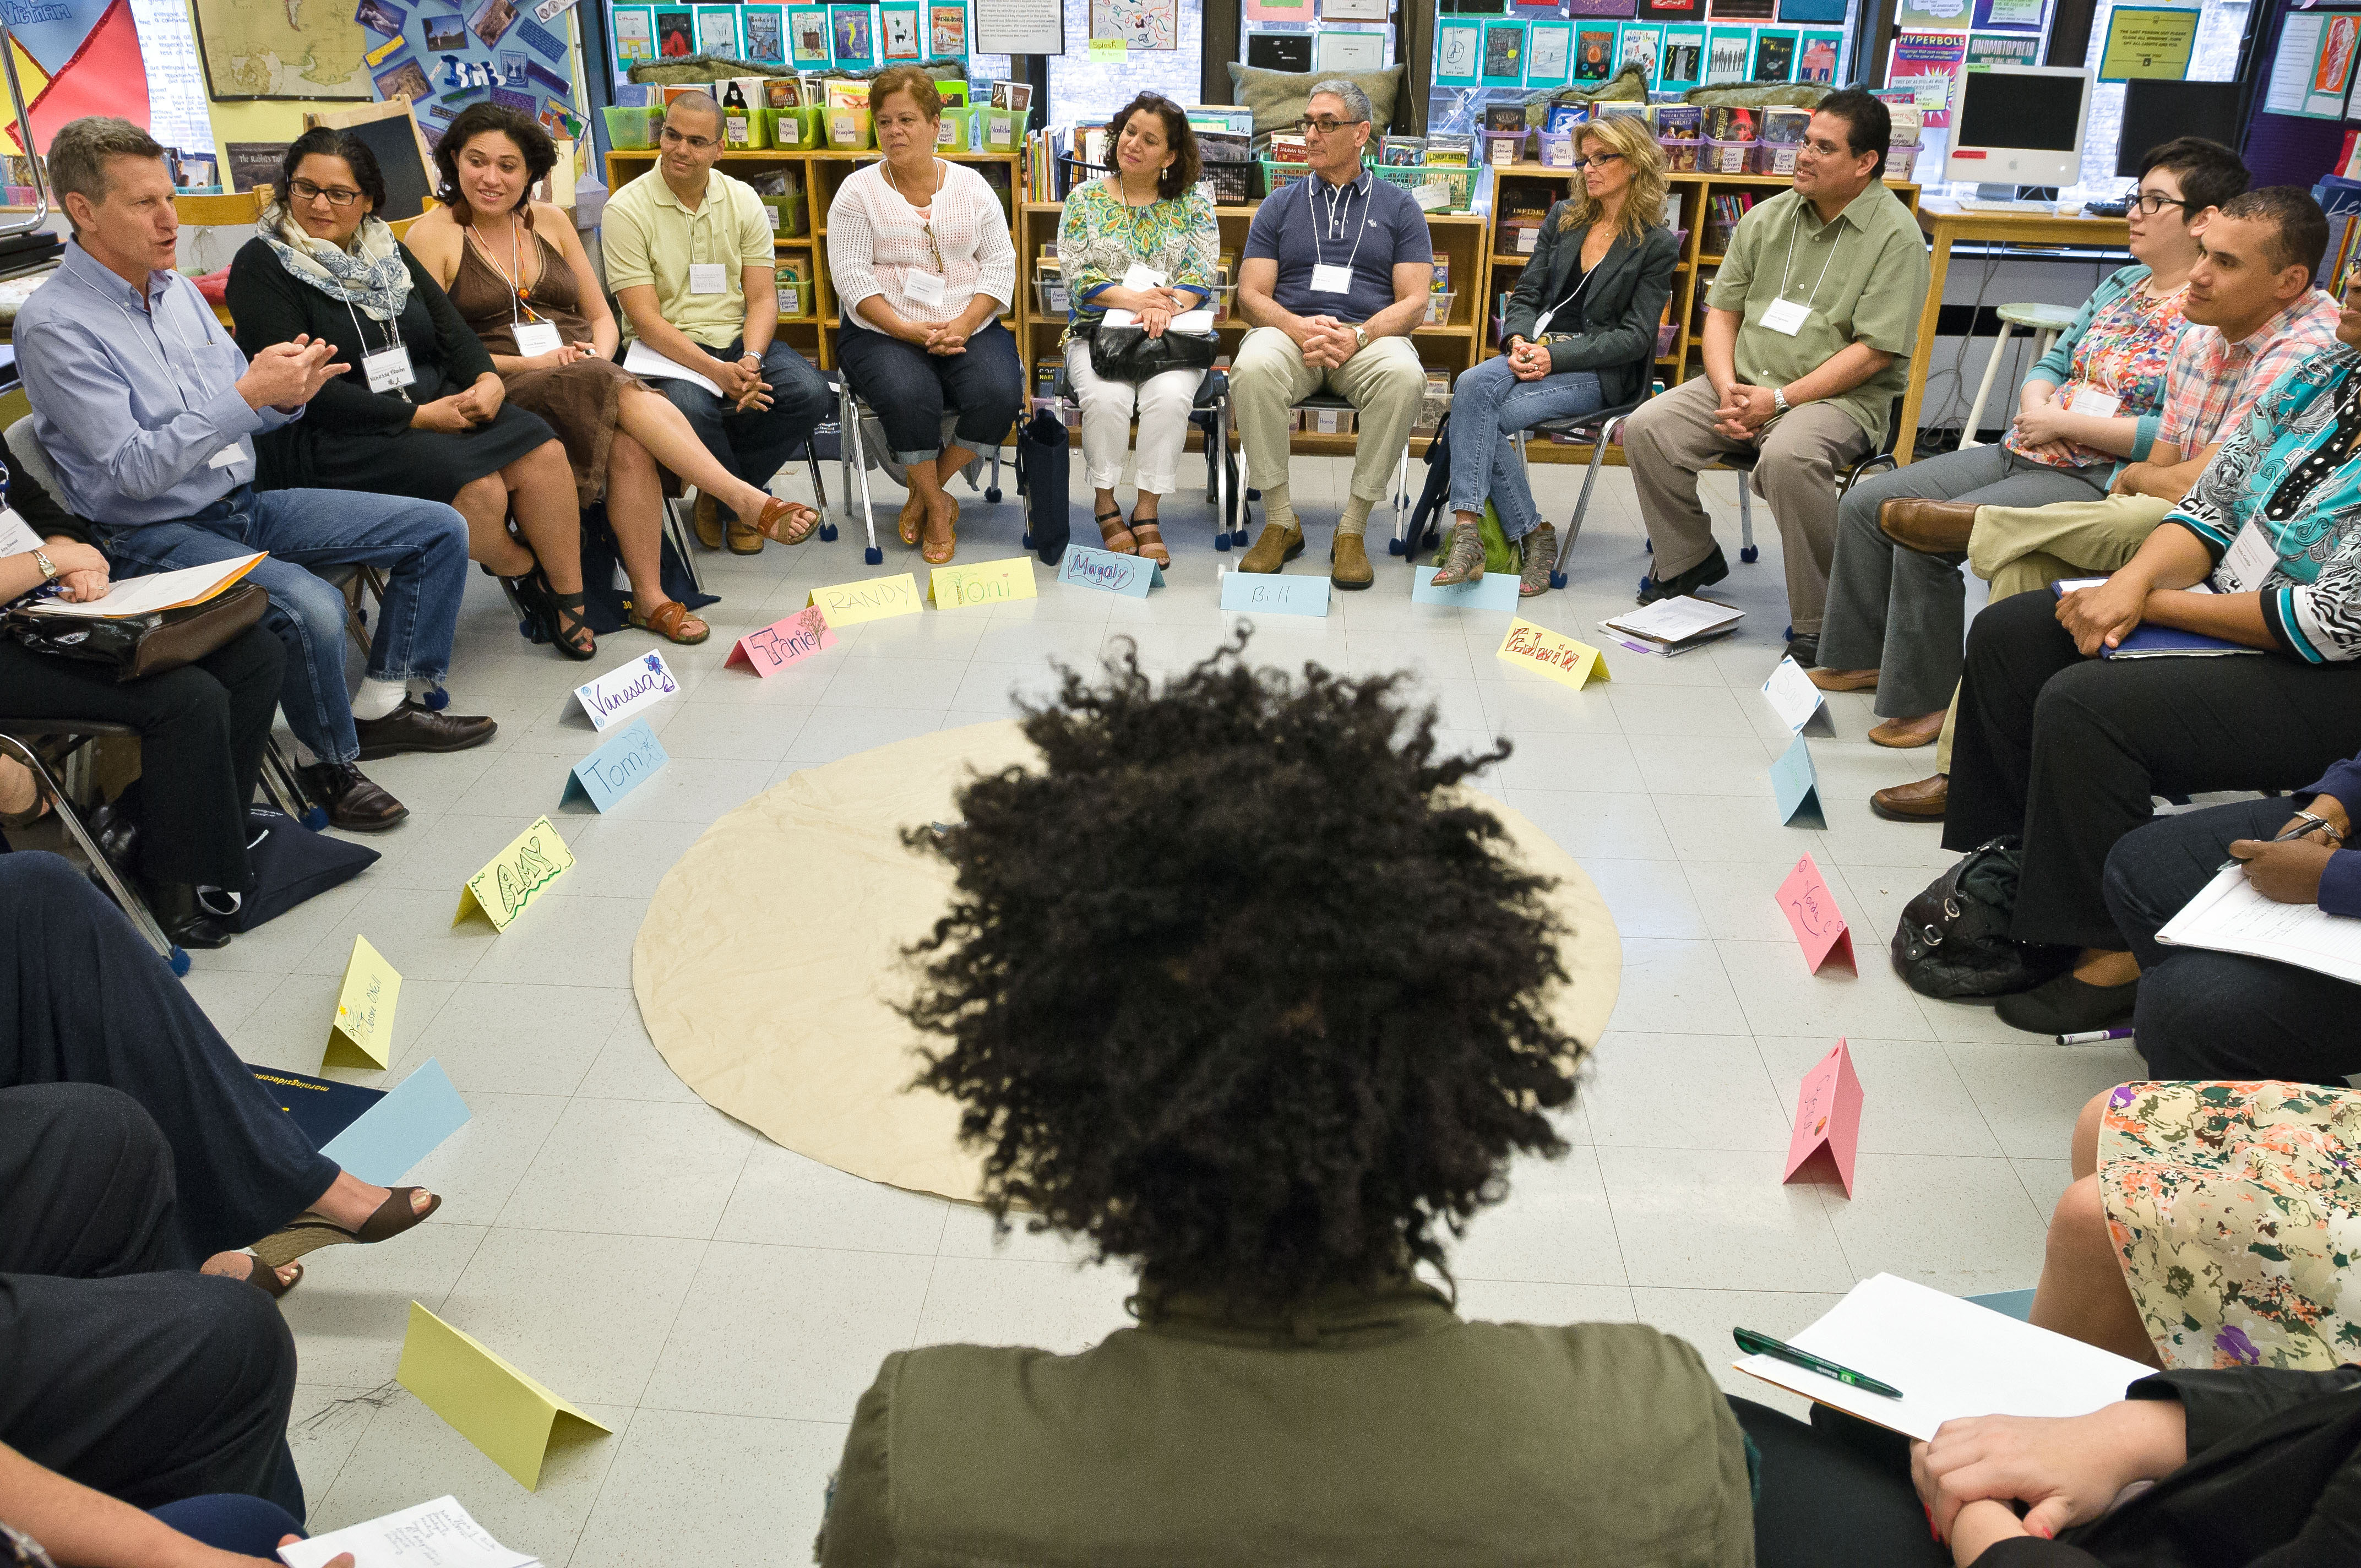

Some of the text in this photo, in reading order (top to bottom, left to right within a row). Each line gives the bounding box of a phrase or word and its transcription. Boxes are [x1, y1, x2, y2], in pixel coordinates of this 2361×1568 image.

[1092, 40, 1117, 49] Splash
[1899, 35, 1965, 46] HYPERBOLE
[1971, 39, 2035, 57] ONOMATOPOEIA
[771, 92, 795, 103] MIRACLE
[1715, 108, 1727, 138] WARS
[1429, 153, 1467, 162] LEMONY SNICKET
[1555, 146, 1567, 155] Spy
[1513, 208, 1546, 216] INFIDEL
[1070, 553, 1128, 588] Magaly
[828, 580, 910, 614] RANDY
[1251, 585, 1290, 605] Bill
[748, 627, 817, 666] Tania
[1505, 627, 1580, 672] Edwin
[587, 672, 666, 717] Vanessa
[1777, 669, 1803, 714] Sara
[583, 751, 644, 794] Tom
[497, 836, 554, 914] AMY
[1816, 1365, 1853, 1384] TD Bank
